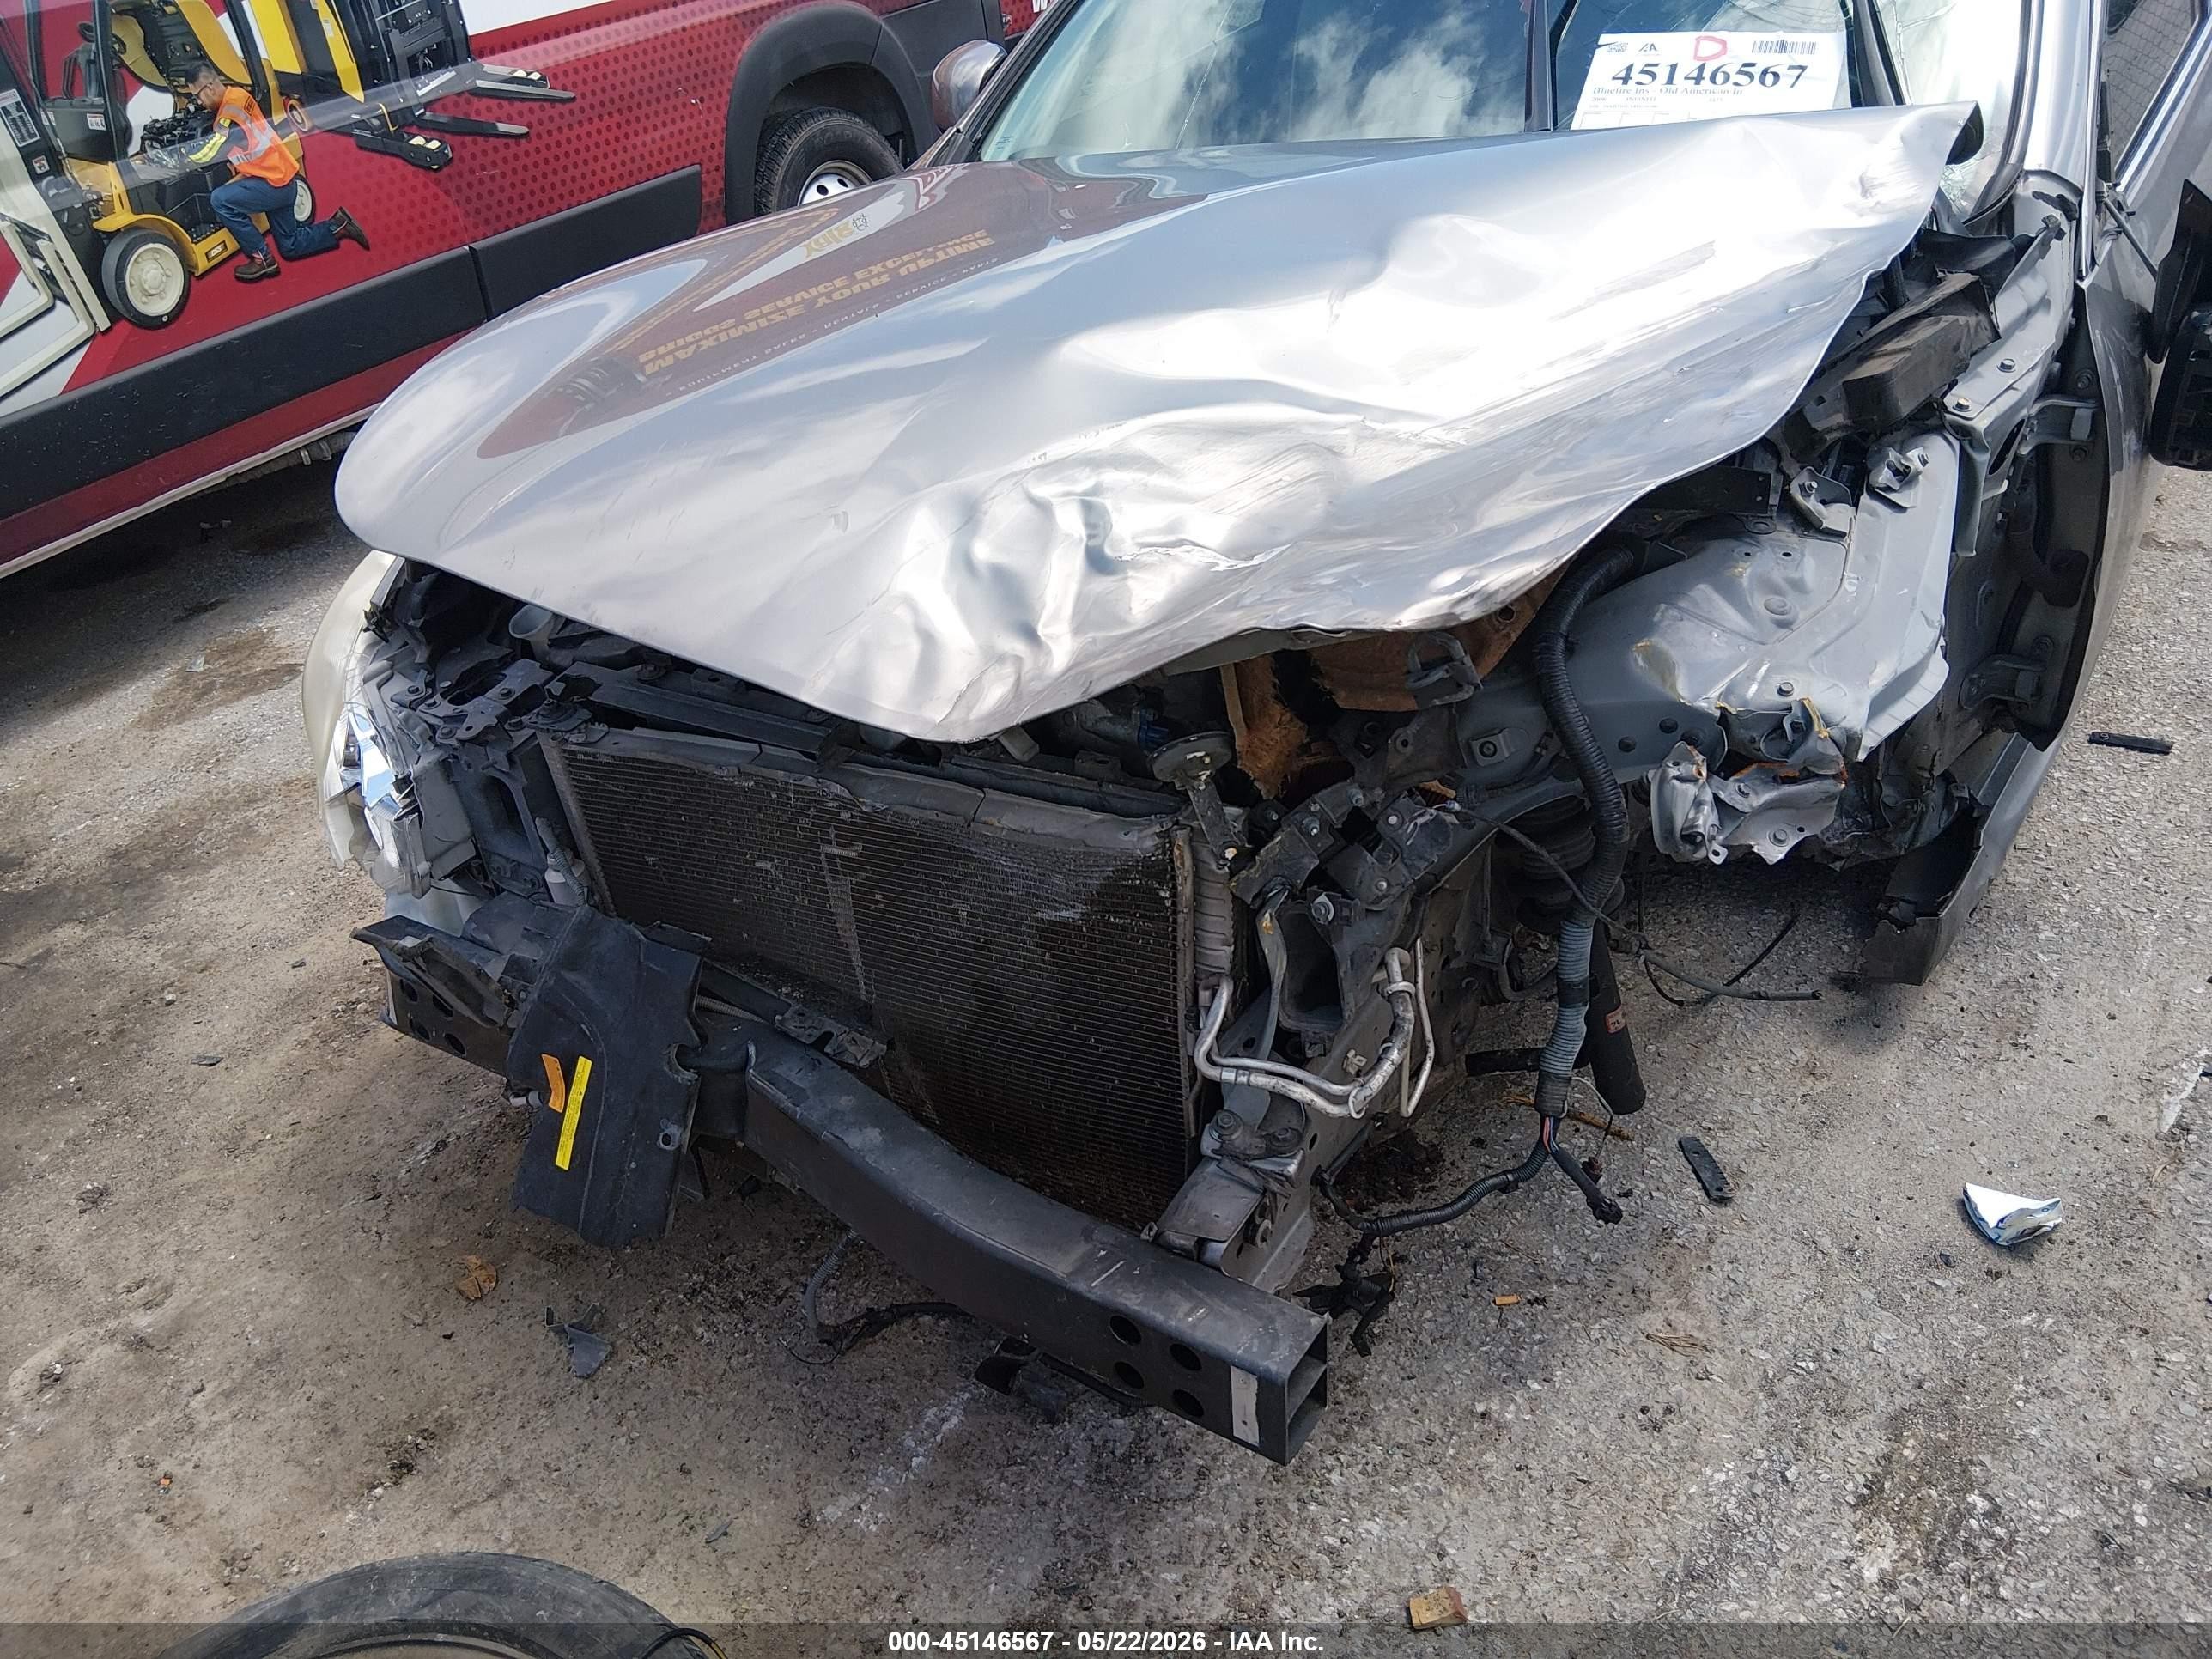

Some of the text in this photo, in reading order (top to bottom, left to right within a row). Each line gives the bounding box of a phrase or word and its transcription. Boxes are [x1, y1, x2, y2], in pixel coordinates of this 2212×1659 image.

[1693, 35, 1728, 62] D
[1611, 62, 1808, 88] 45146567
[1593, 87, 1632, 95] Bluefire
[1635, 87, 1650, 95] Ins
[1659, 87, 1678, 95] Old
